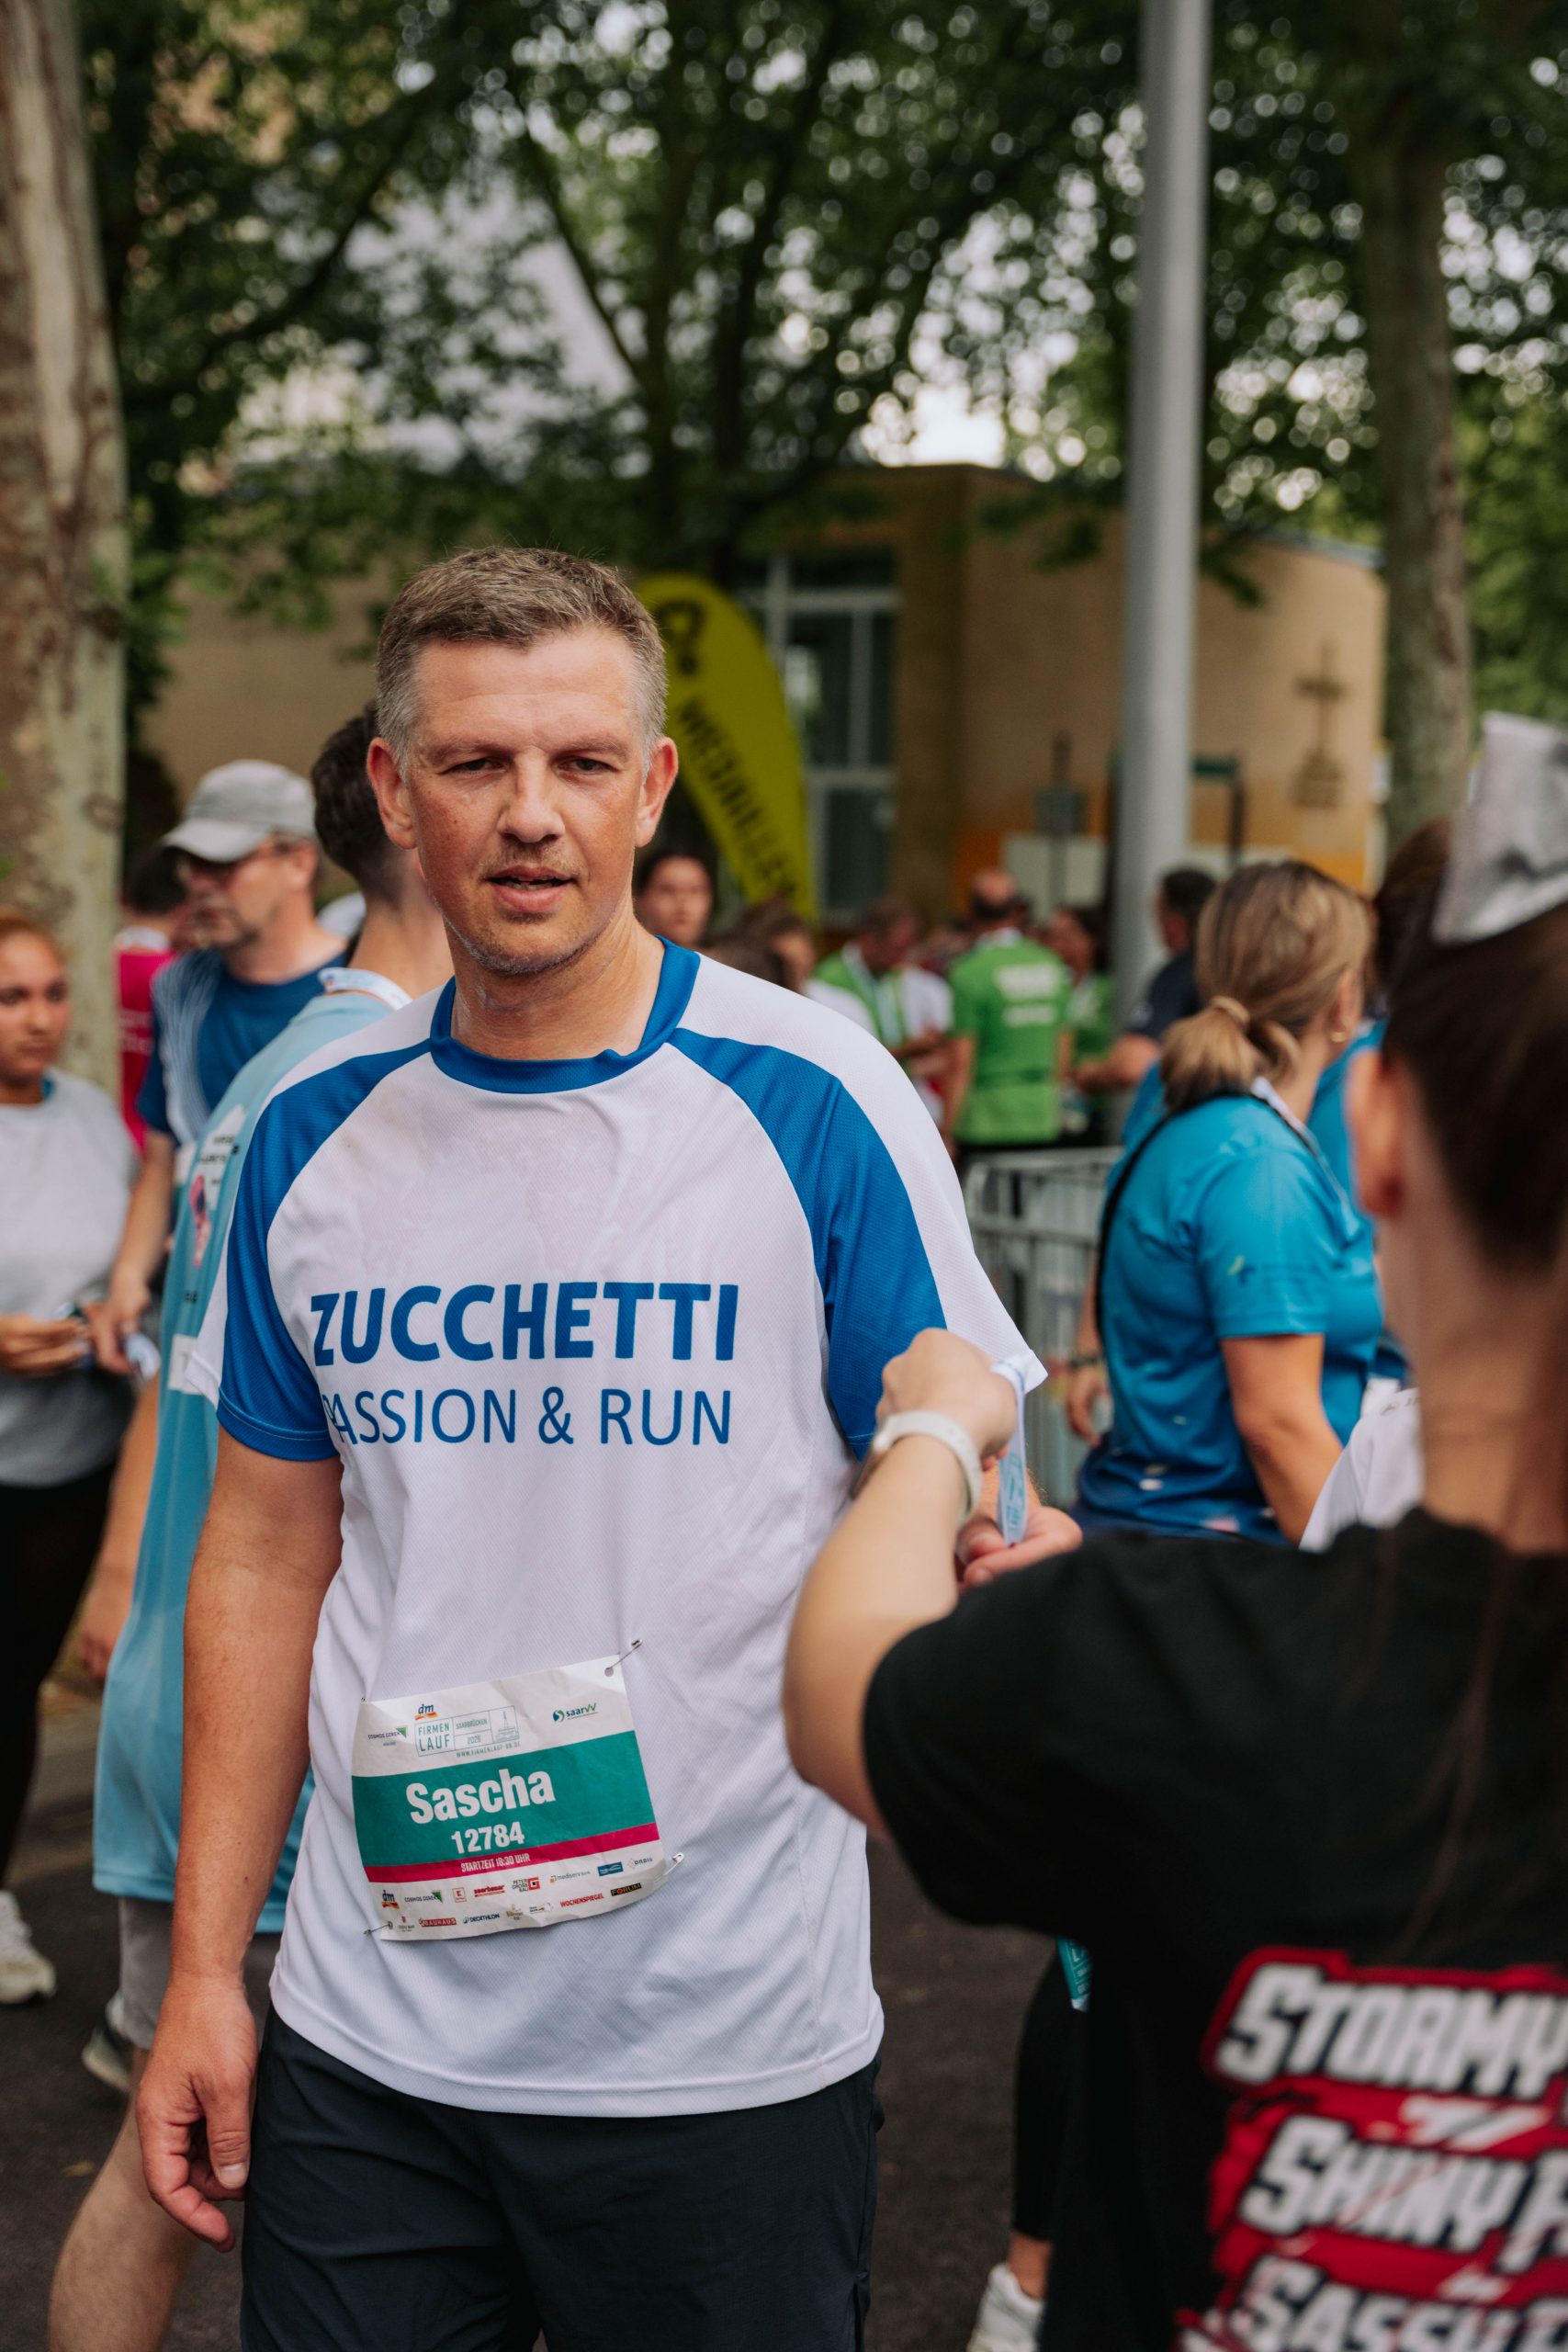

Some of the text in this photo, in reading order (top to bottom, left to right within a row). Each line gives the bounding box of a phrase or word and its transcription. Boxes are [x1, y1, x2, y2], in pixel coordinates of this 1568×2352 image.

[310, 1282, 739, 1367] ZUCCHETTI
[537, 1385, 574, 1445] &
[600, 1387, 732, 1446] RUN
[418, 1703, 434, 1714] dm
[418, 1722, 450, 1736] FIRMEN
[419, 1735, 450, 1752] LAUF
[405, 1768, 557, 1825] Sascha
[451, 1821, 525, 1854] 12784
[460, 1859, 495, 1873] STARTZEIT
[514, 1852, 531, 1864] UHR
[382, 1889, 396, 1902] dm
[560, 1893, 604, 1907] WOCHENSPIEGEL
[422, 1917, 456, 1927] BAUHAUS
[469, 1913, 501, 1923] DECATHLON
